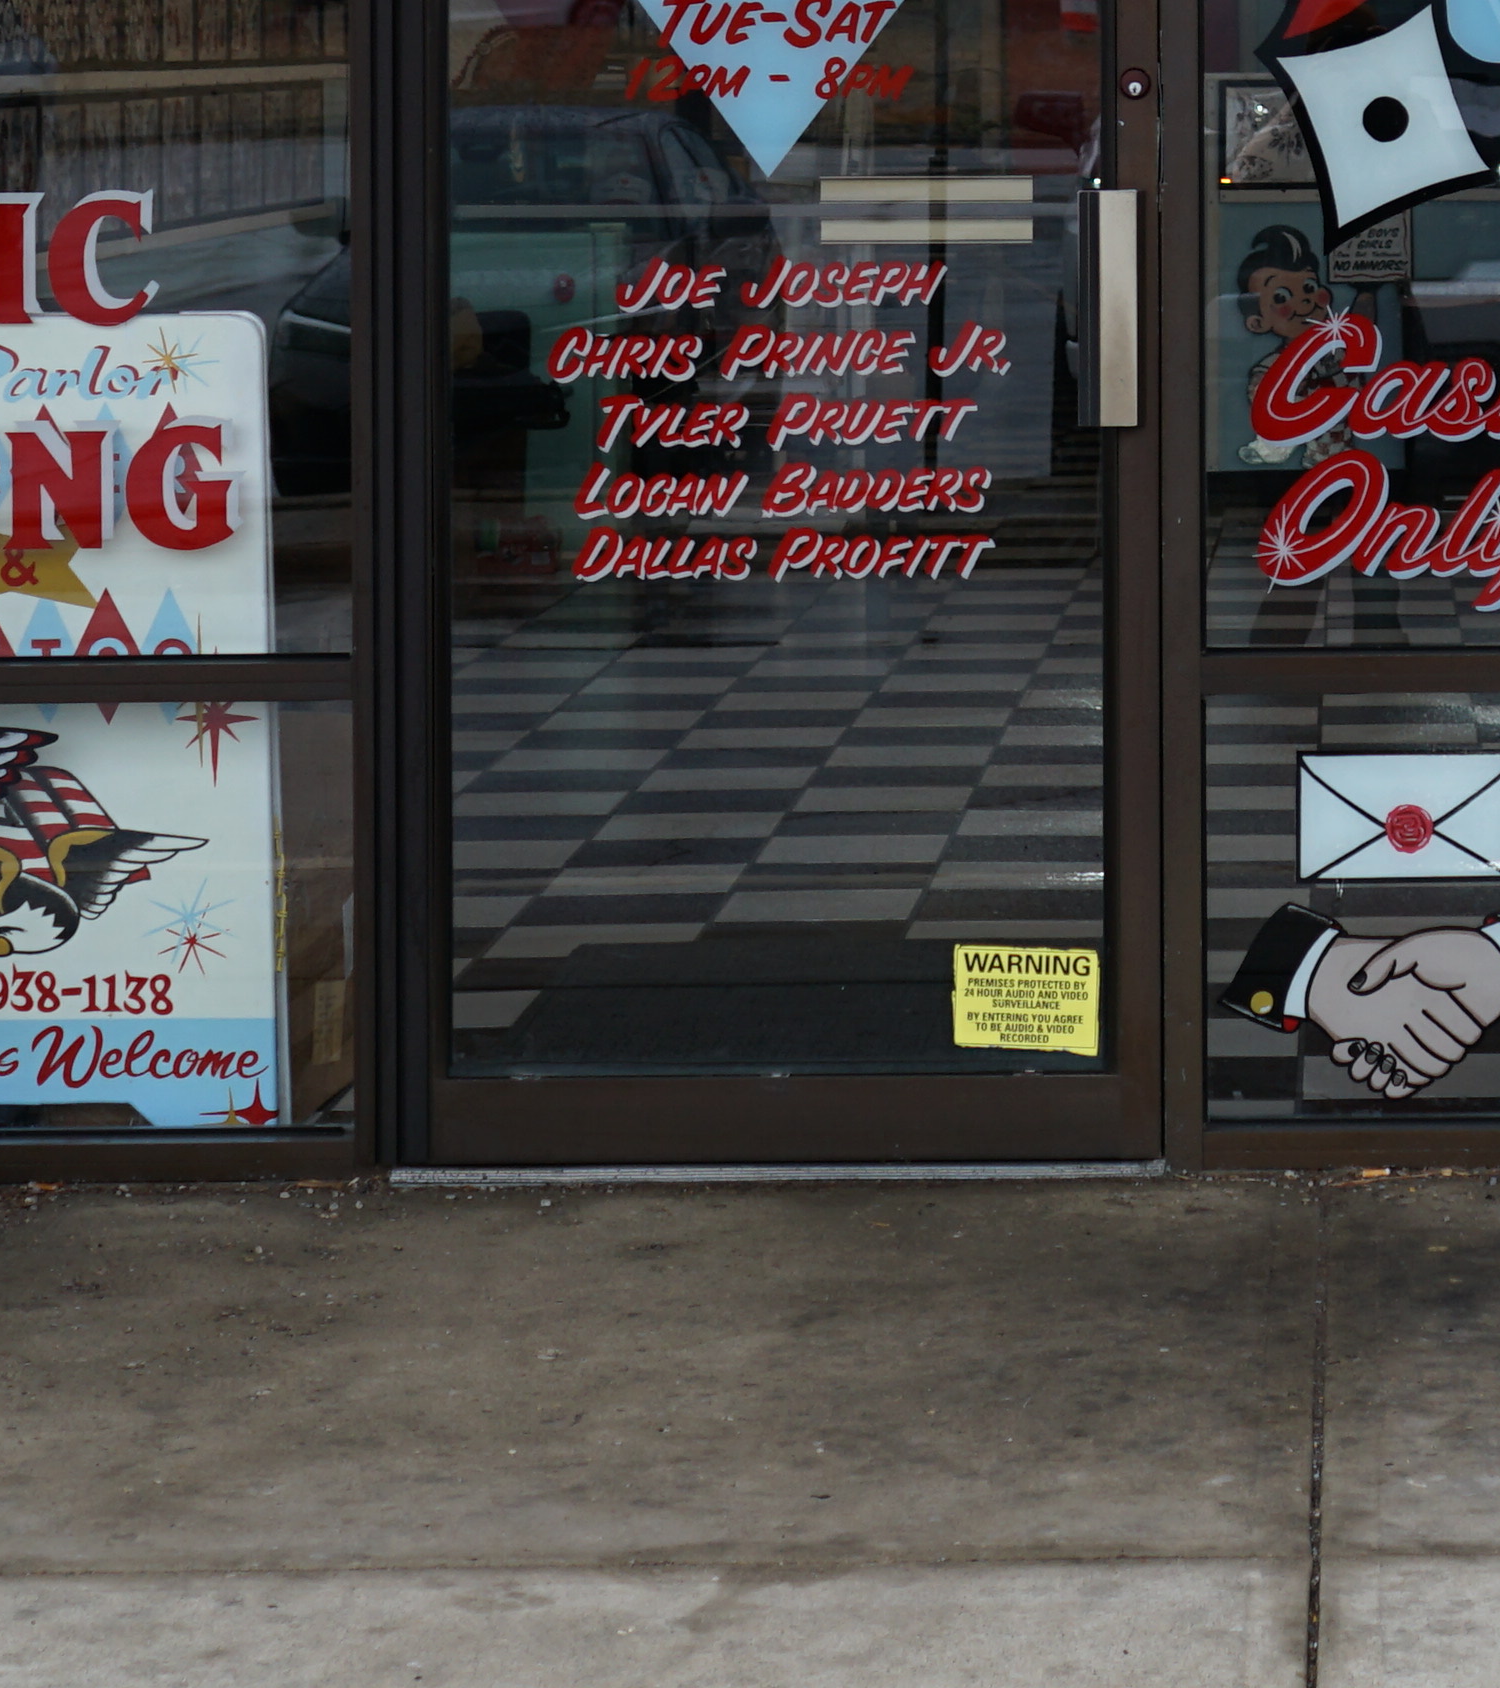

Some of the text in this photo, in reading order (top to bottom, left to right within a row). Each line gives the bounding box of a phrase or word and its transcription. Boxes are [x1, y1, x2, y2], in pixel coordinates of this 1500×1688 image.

[625, 55, 751, 102] 12PM
[815, 55, 915, 101] 8PM
[1333, 260, 1351, 271] NO
[615, 254, 948, 312] JOE JOSEPH
[547, 321, 1012, 383] CHRIS PRINCE JR.
[596, 392, 978, 453] TYLER PRUETT
[573, 461, 992, 520] LOGAN BADDERS
[0, 548, 40, 587] &
[572, 525, 997, 583] DALLAS PROFITT
[964, 953, 1091, 976] WARNING
[964, 988, 1089, 1001] 24 HOUR AUDIO AND VIDEO
[967, 978, 1087, 991] PREMISES PROTECTED BY
[967, 1012, 1084, 1025] BY ENTERING YOU AGREE
[992, 998, 1061, 1010] SURVEILLANCE
[975, 1022, 1075, 1035] TO BE AUDIO & VIDEO
[1000, 1033, 1050, 1044] RECORDED
[31, 1026, 269, 1088] Welcome
